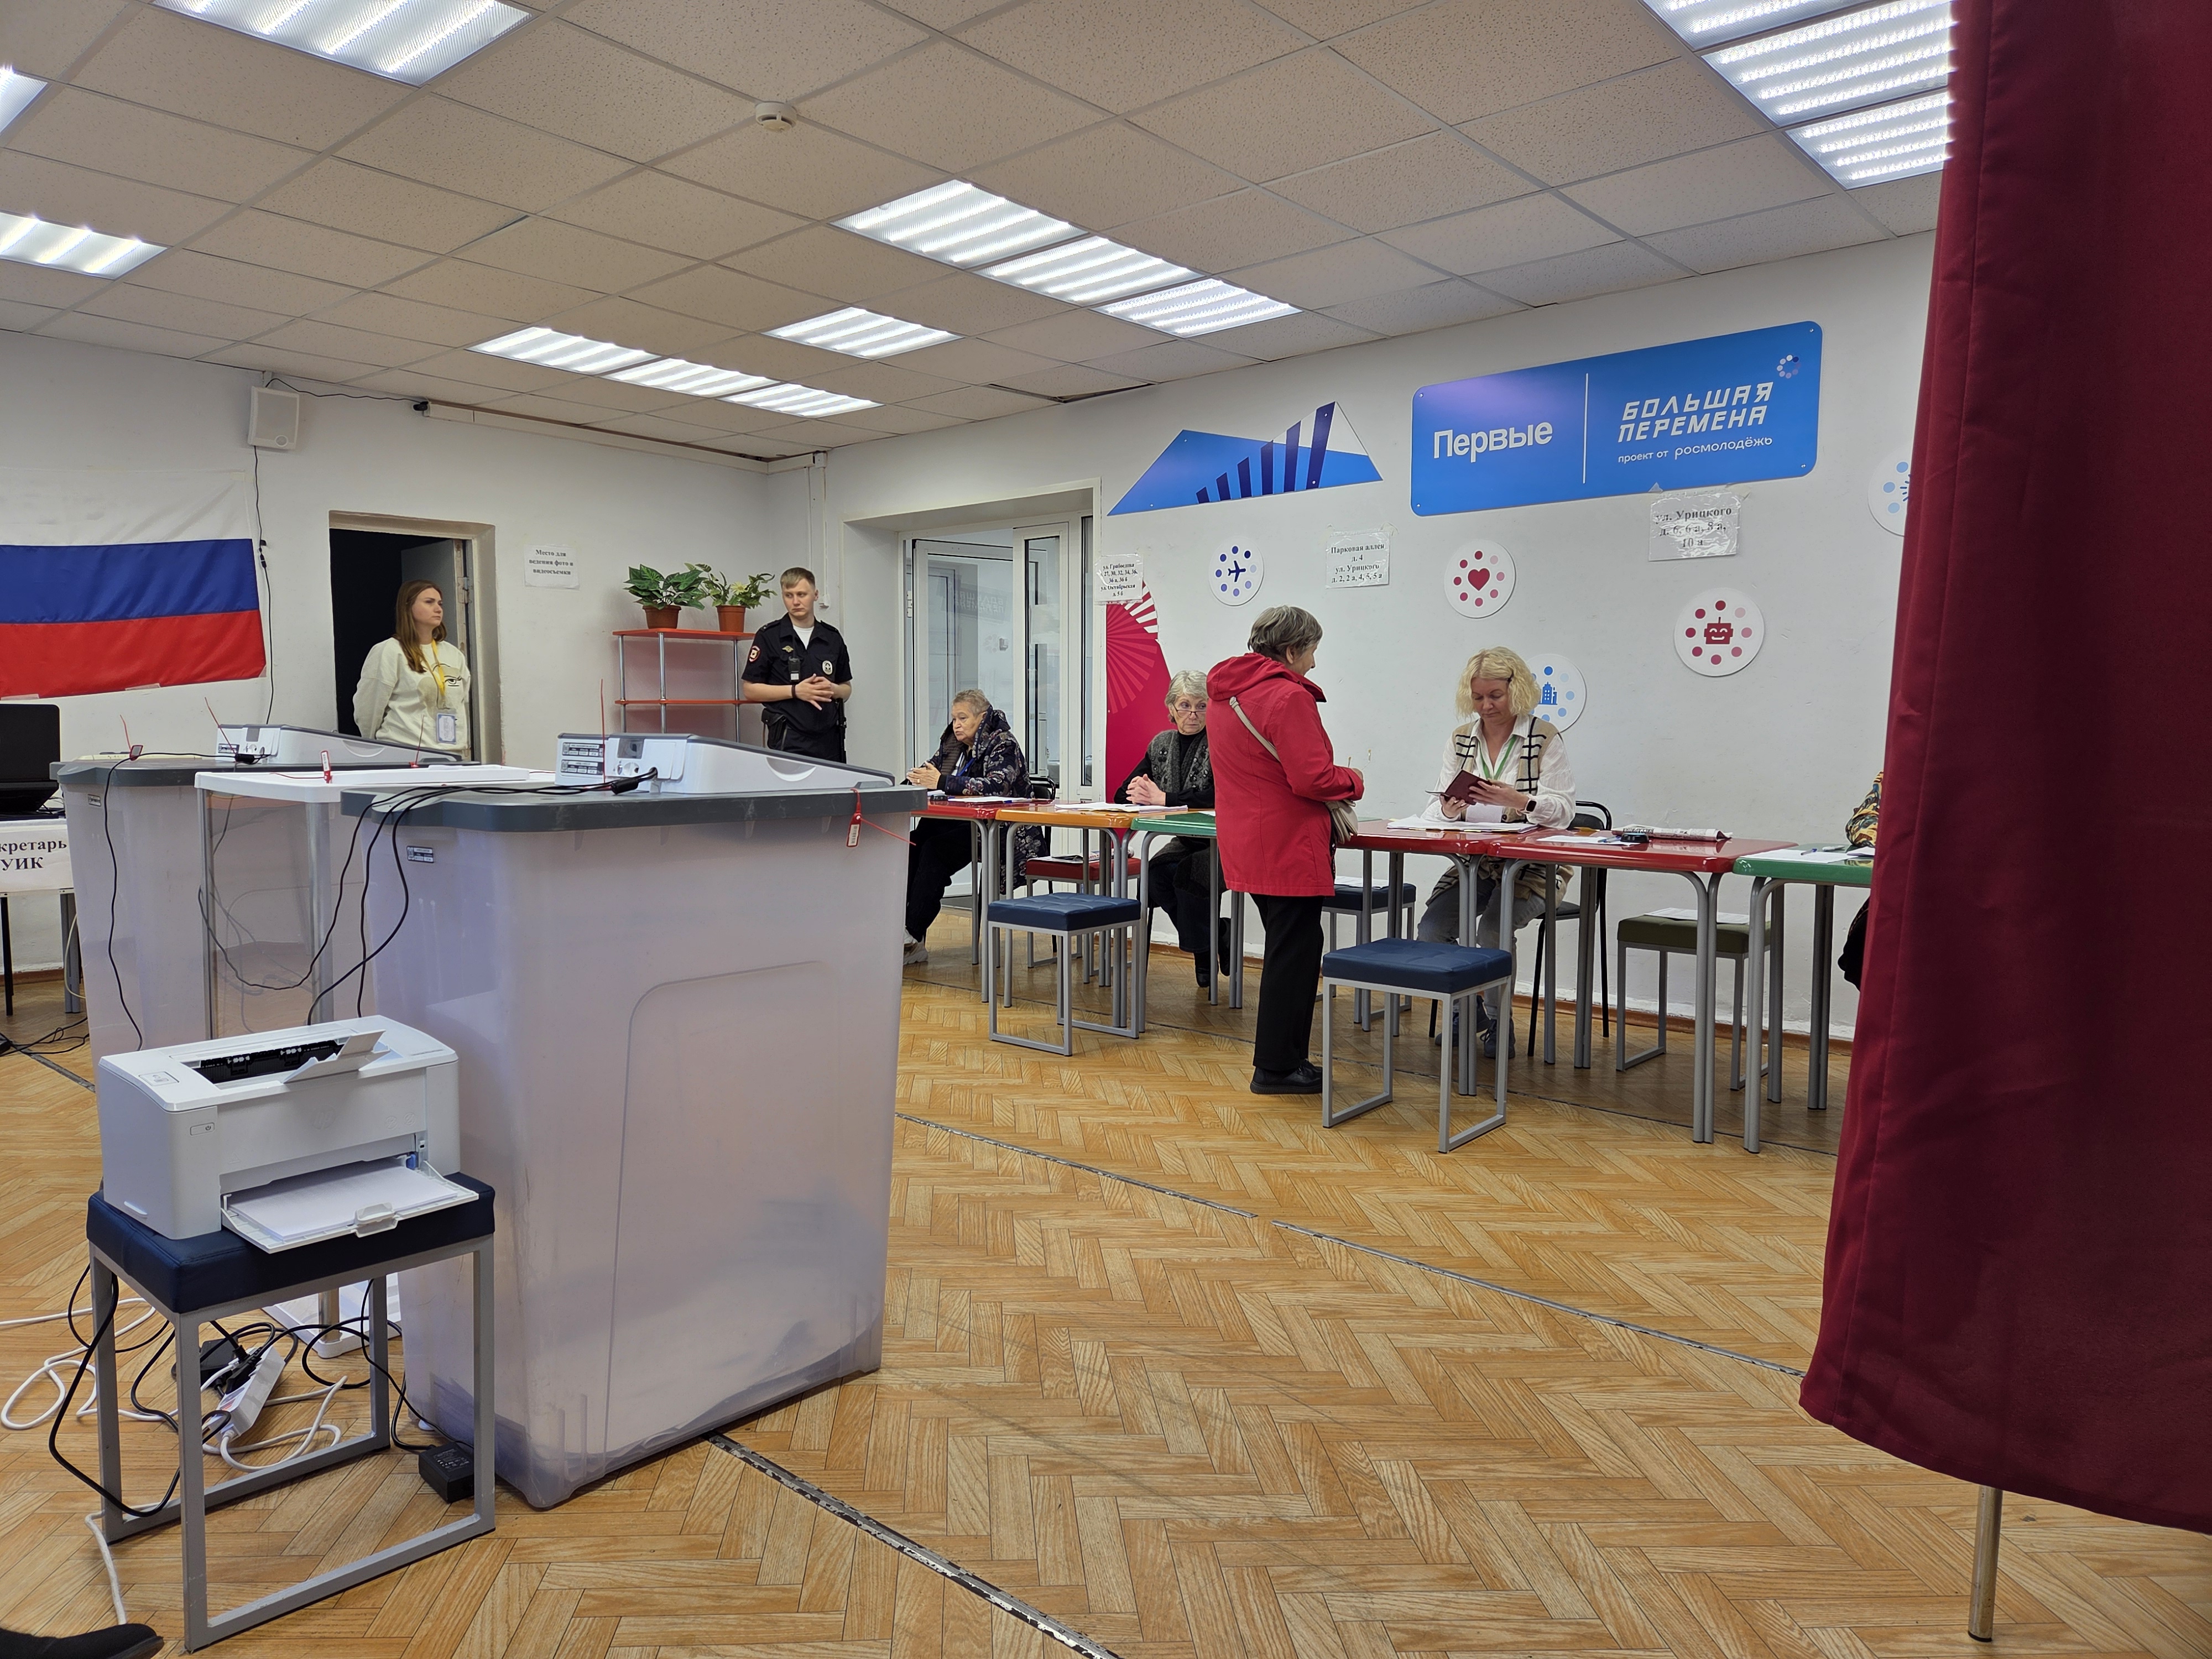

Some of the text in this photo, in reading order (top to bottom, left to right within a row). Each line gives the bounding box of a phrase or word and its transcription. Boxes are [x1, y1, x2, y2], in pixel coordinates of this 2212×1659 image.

[1622, 382, 1773, 421] БОЛЬШАЯ
[1618, 405, 1767, 443] ПЕРЕМЕНА
[1434, 422, 1553, 463] Первые
[1618, 436, 1773, 464] проект от росмолодёжь
[1655, 508, 1732, 525] ул. Урицкого
[1673, 525, 1682, 535] 6,
[1708, 521, 1713, 531] 8
[1717, 523, 1726, 532] а,
[1682, 538, 1694, 547] 10
[1331, 546, 1364, 555] Парковая
[1347, 564, 1380, 573] Урицкого
[0, 857, 43, 870] УИК
